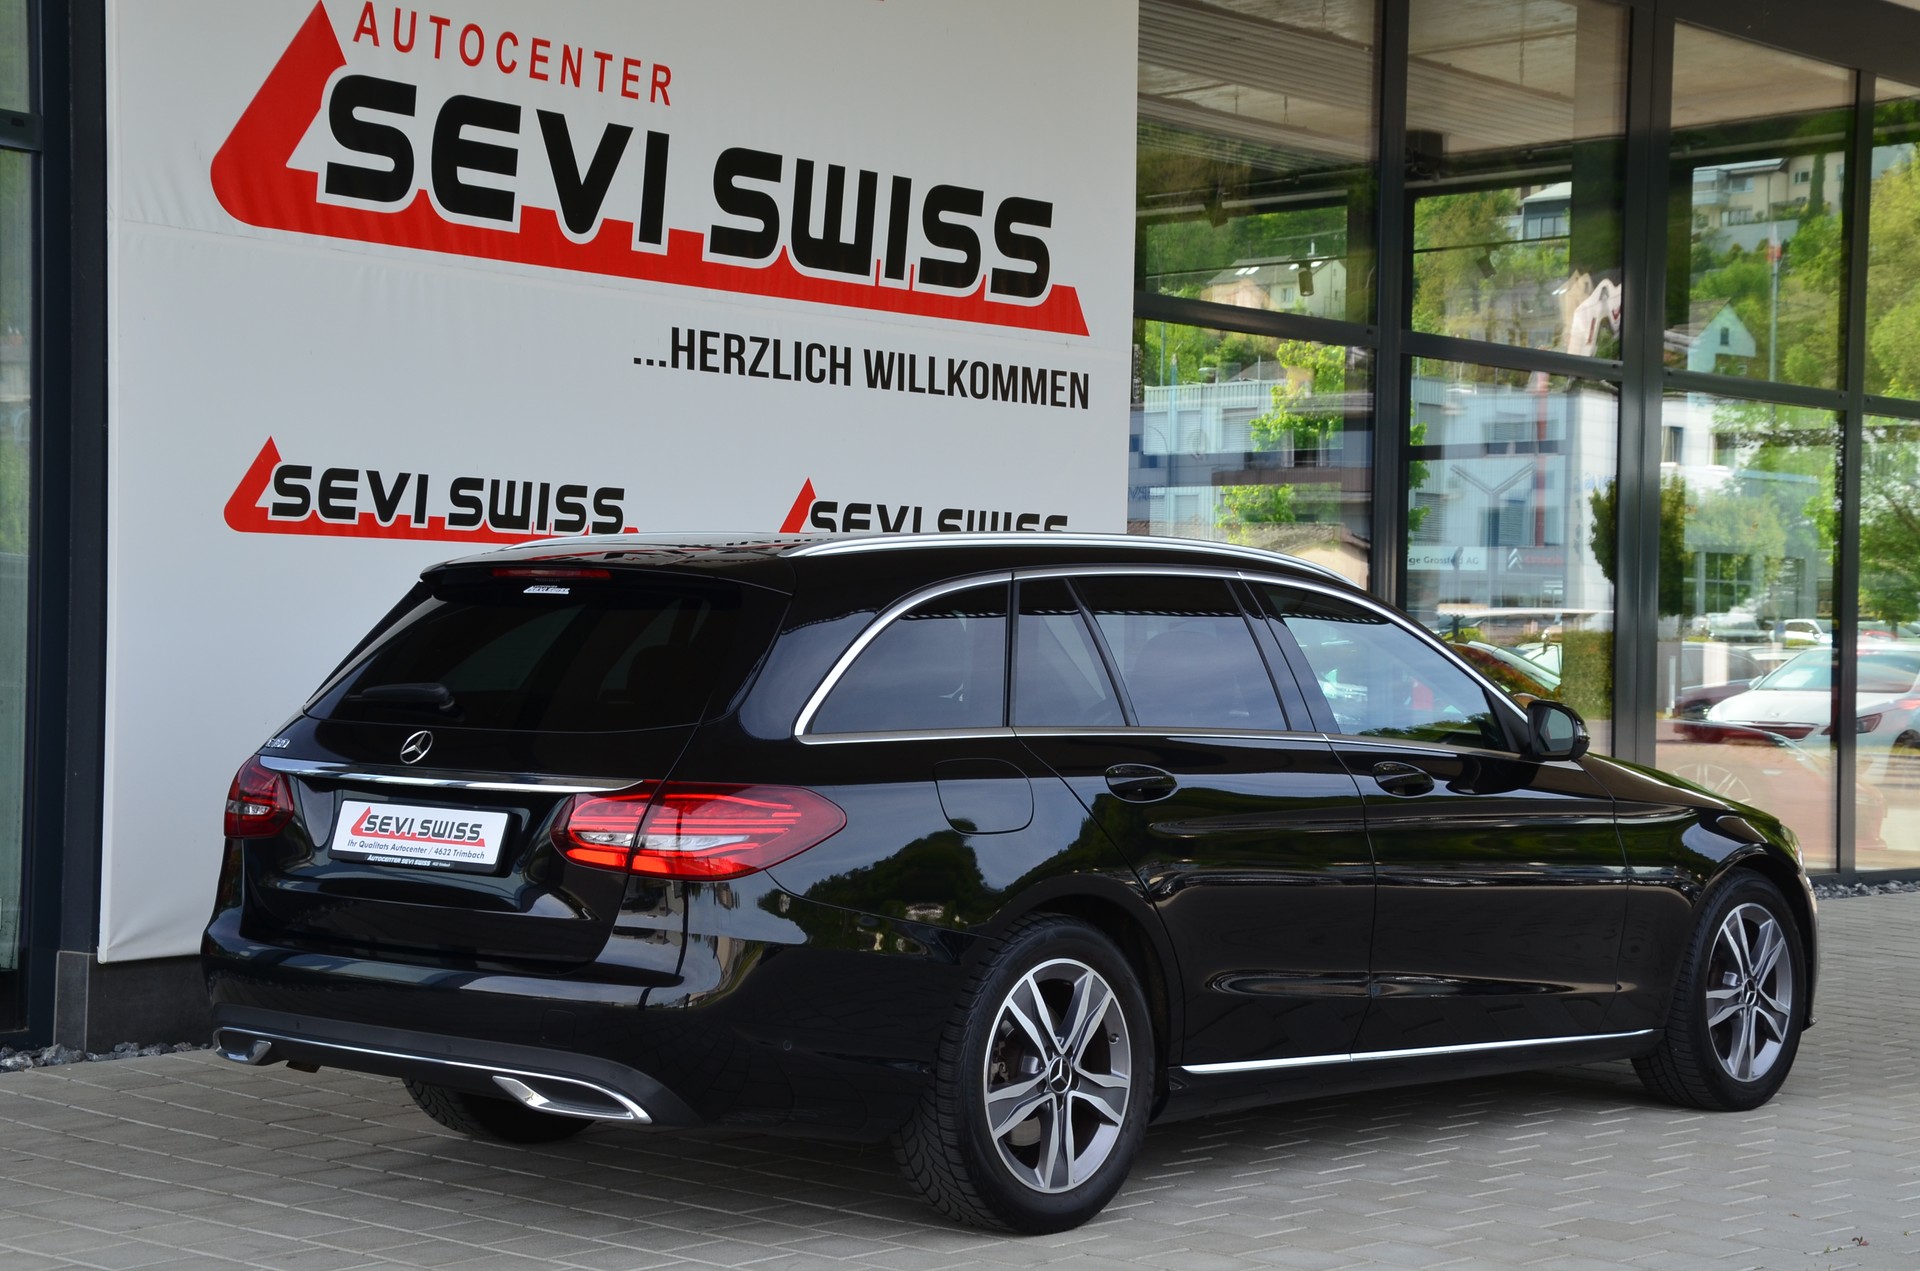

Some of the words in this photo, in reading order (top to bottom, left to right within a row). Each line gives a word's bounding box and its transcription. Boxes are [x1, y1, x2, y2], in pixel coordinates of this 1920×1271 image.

[354, 0, 672, 107] AUTOCENTER
[325, 74, 669, 246] SEVI
[709, 147, 1054, 299] SWISS
[864, 349, 1089, 410] WILLKOMMEN
[272, 464, 428, 524] SEVI
[448, 477, 625, 535] SWISS
[1423, 556, 1463, 565] Grossfd
[1466, 556, 1479, 565] AG
[347, 839, 358, 847] Ihr
[390, 843, 428, 854] Autocenter
[434, 846, 452, 857] 4632
[453, 848, 485, 860] Trimbach
[364, 814, 415, 834] SEVI
[417, 819, 482, 841] SWISS
